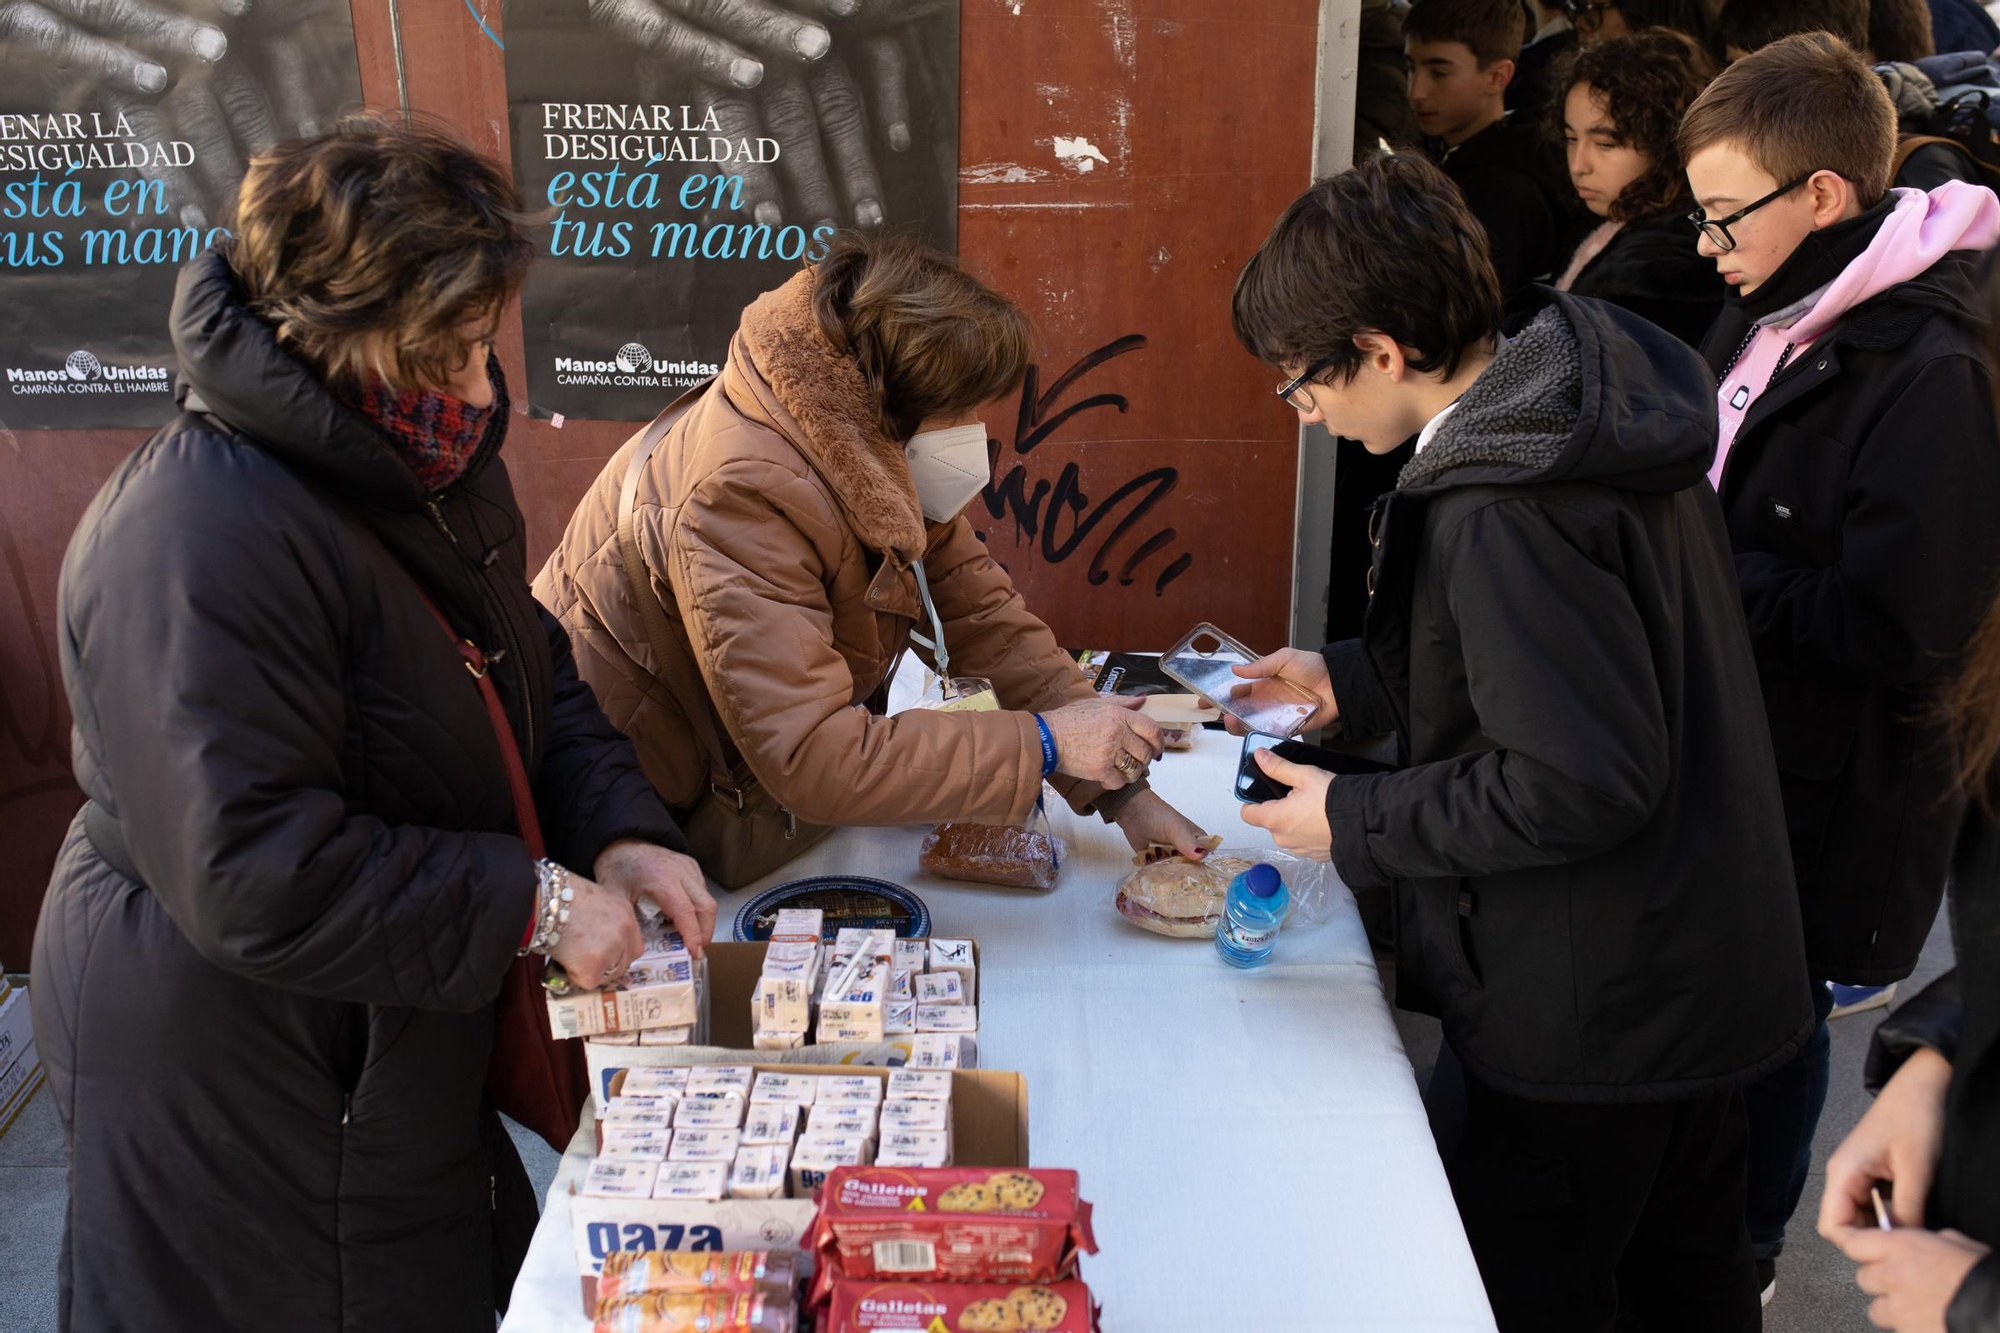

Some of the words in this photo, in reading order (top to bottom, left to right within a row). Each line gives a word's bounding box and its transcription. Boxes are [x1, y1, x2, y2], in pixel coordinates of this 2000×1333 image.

[0, 112, 87, 141] ENAR
[94, 112, 136, 138] LA
[541, 103, 674, 131] FRENAR
[680, 105, 722, 131] LA
[543, 133, 781, 163] DESIGUALDAD
[547, 152, 663, 209] está
[678, 173, 746, 210] en
[103, 178, 170, 216] en
[0, 230, 65, 268] us
[550, 210, 634, 258] tus
[649, 220, 835, 261] manos
[6, 368, 68, 382] Manos
[103, 365, 168, 380] Unidas
[555, 357, 616, 372] Manos
[653, 360, 719, 375] Unidas
[557, 373, 612, 386] CAMPAÑA
[614, 376, 659, 387] CONTRA
[662, 377, 673, 387] EL
[12, 382, 66, 395] CAMPAÑA
[67, 383, 111, 394] CONTRA
[114, 383, 125, 393] EL
[127, 381, 169, 393] HAMBRE
[844, 1178, 929, 1197] Galletas
[587, 1222, 724, 1271] gaza
[860, 1299, 947, 1315] Galletas
